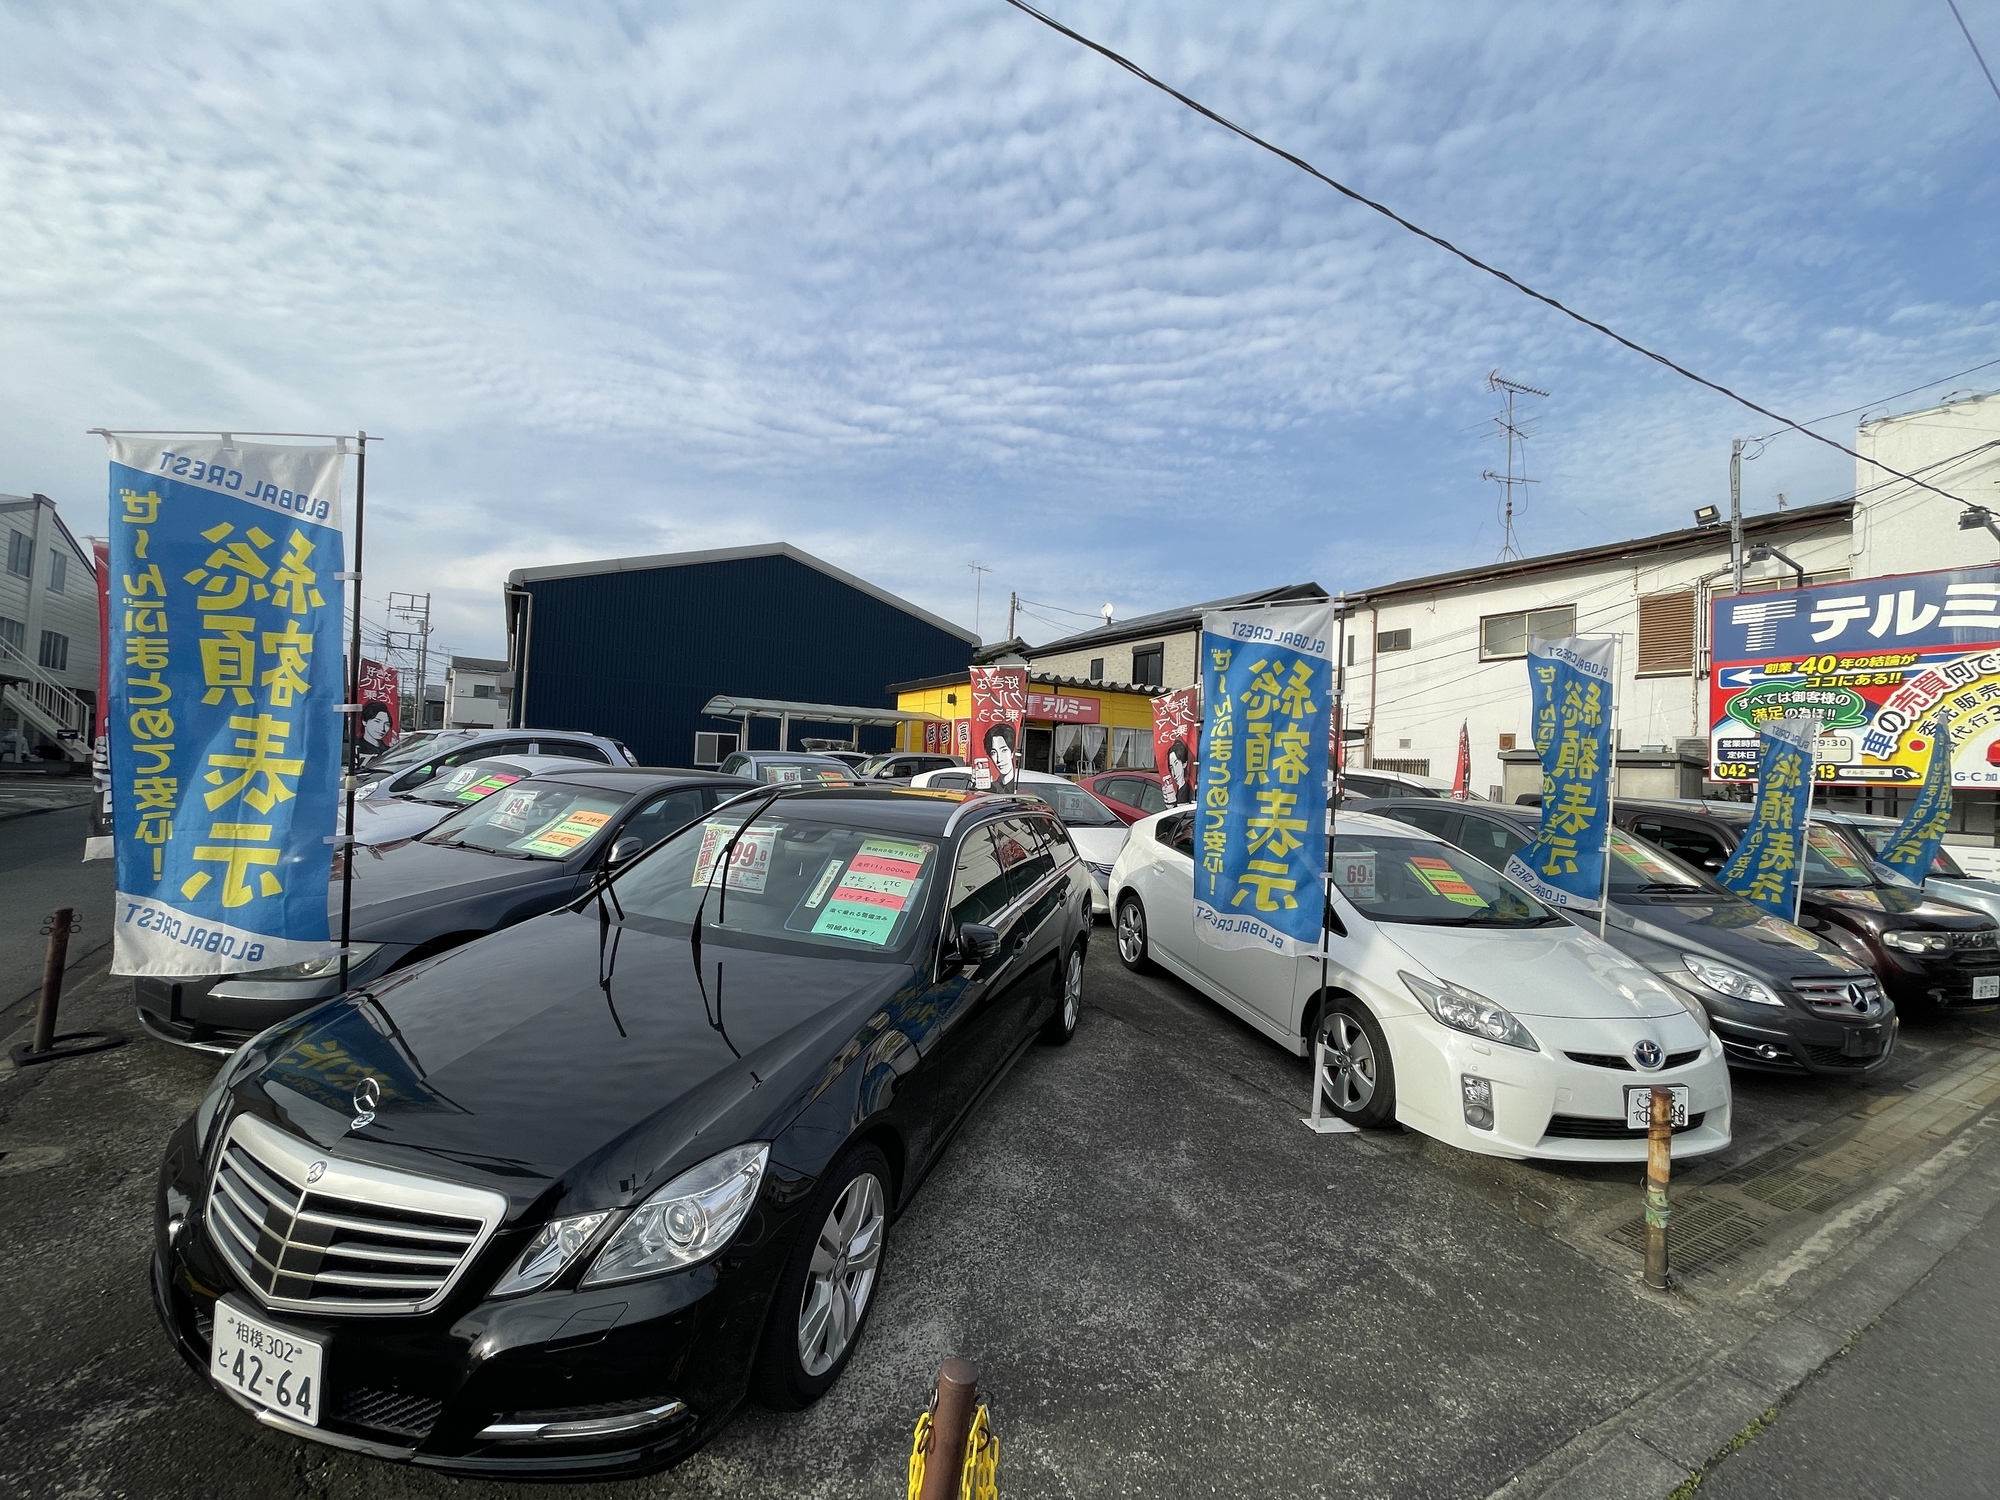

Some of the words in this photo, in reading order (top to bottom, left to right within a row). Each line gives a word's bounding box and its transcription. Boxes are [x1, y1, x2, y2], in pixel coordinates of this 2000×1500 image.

[360, 676, 396, 693] クルマ
[1043, 696, 1092, 715] テルミー
[1736, 690, 1851, 711] すべては御客様の
[1861, 653, 2000, 757] 車の売買何で
[1727, 751, 1756, 759] 定休日
[1346, 864, 1374, 884] 69.8
[839, 892, 894, 904] バックモニター
[218, 1347, 228, 1368] と
[232, 1348, 311, 1416] 42-64
